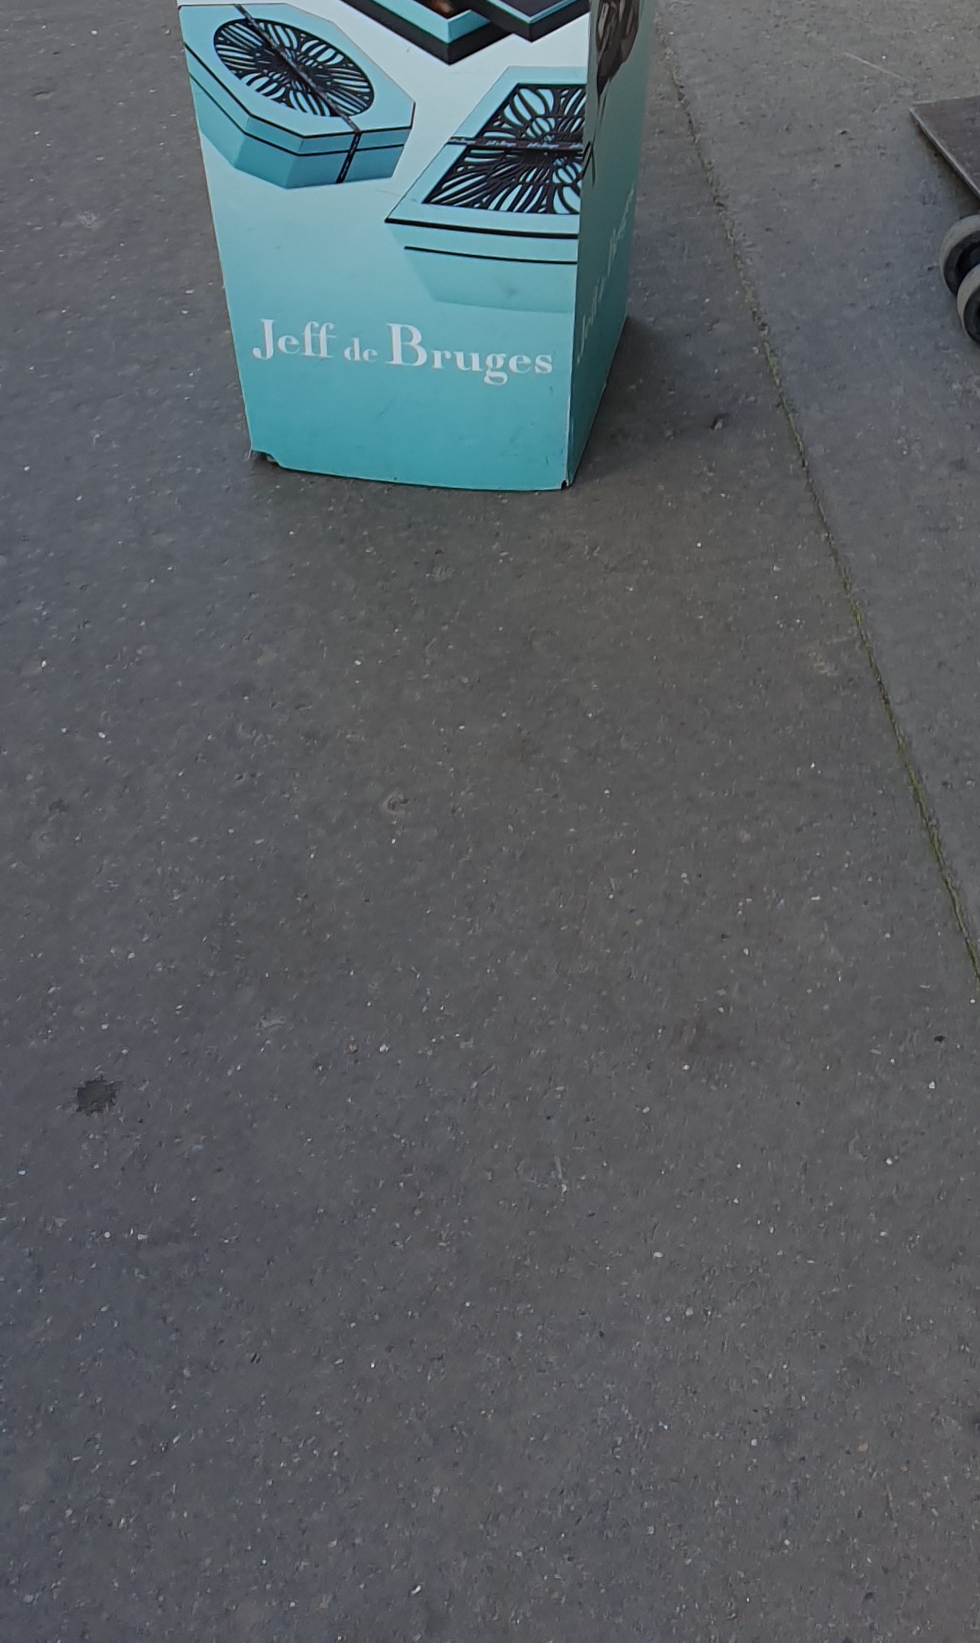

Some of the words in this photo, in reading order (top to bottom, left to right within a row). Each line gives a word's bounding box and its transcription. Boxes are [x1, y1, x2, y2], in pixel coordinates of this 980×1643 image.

[252, 318, 337, 360] Jeff
[344, 337, 378, 362] de
[385, 322, 553, 386] Bruges
